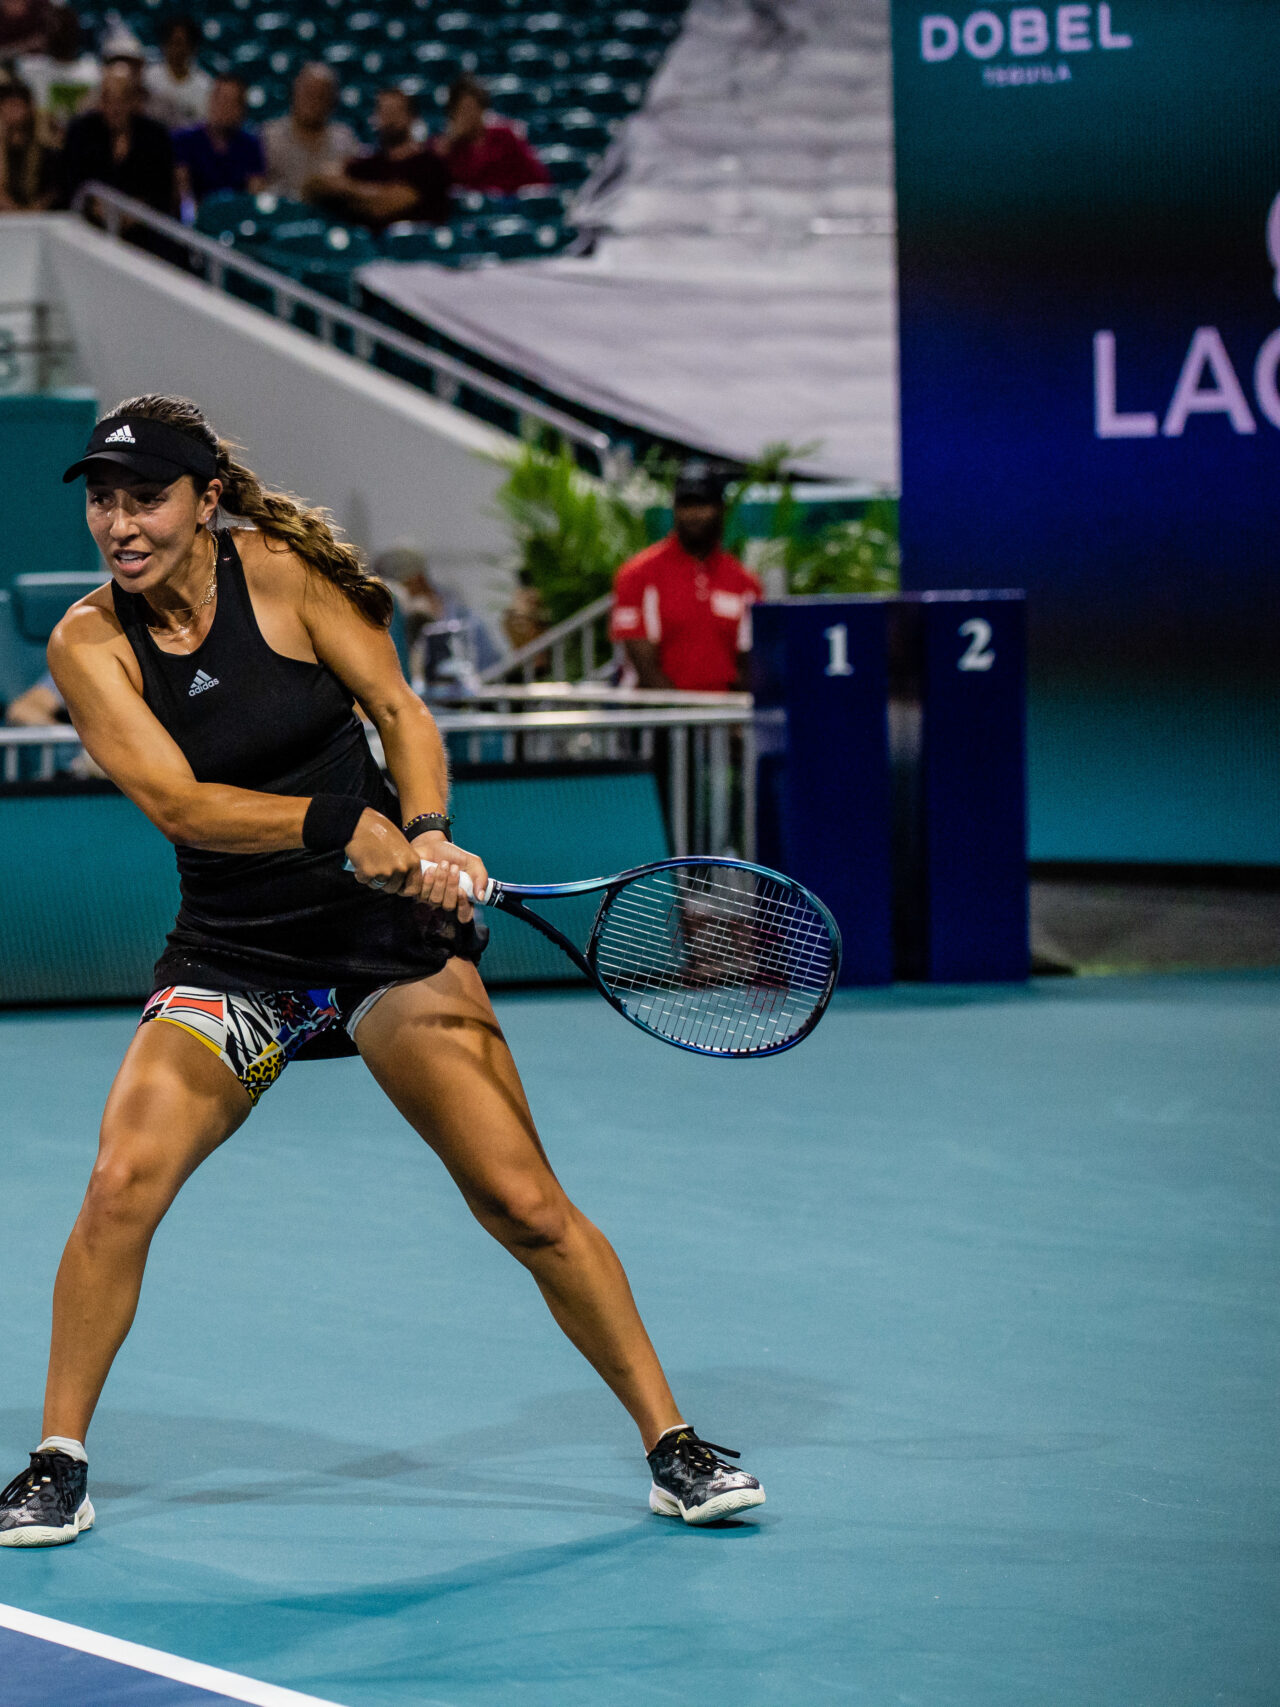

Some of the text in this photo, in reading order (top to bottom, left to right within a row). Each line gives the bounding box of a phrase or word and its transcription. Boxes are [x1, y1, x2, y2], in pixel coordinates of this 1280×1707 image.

[921, 2, 1132, 62] DOBEL
[824, 623, 854, 676] 1
[957, 617, 995, 672] 2
[189, 678, 219, 696] adidas
